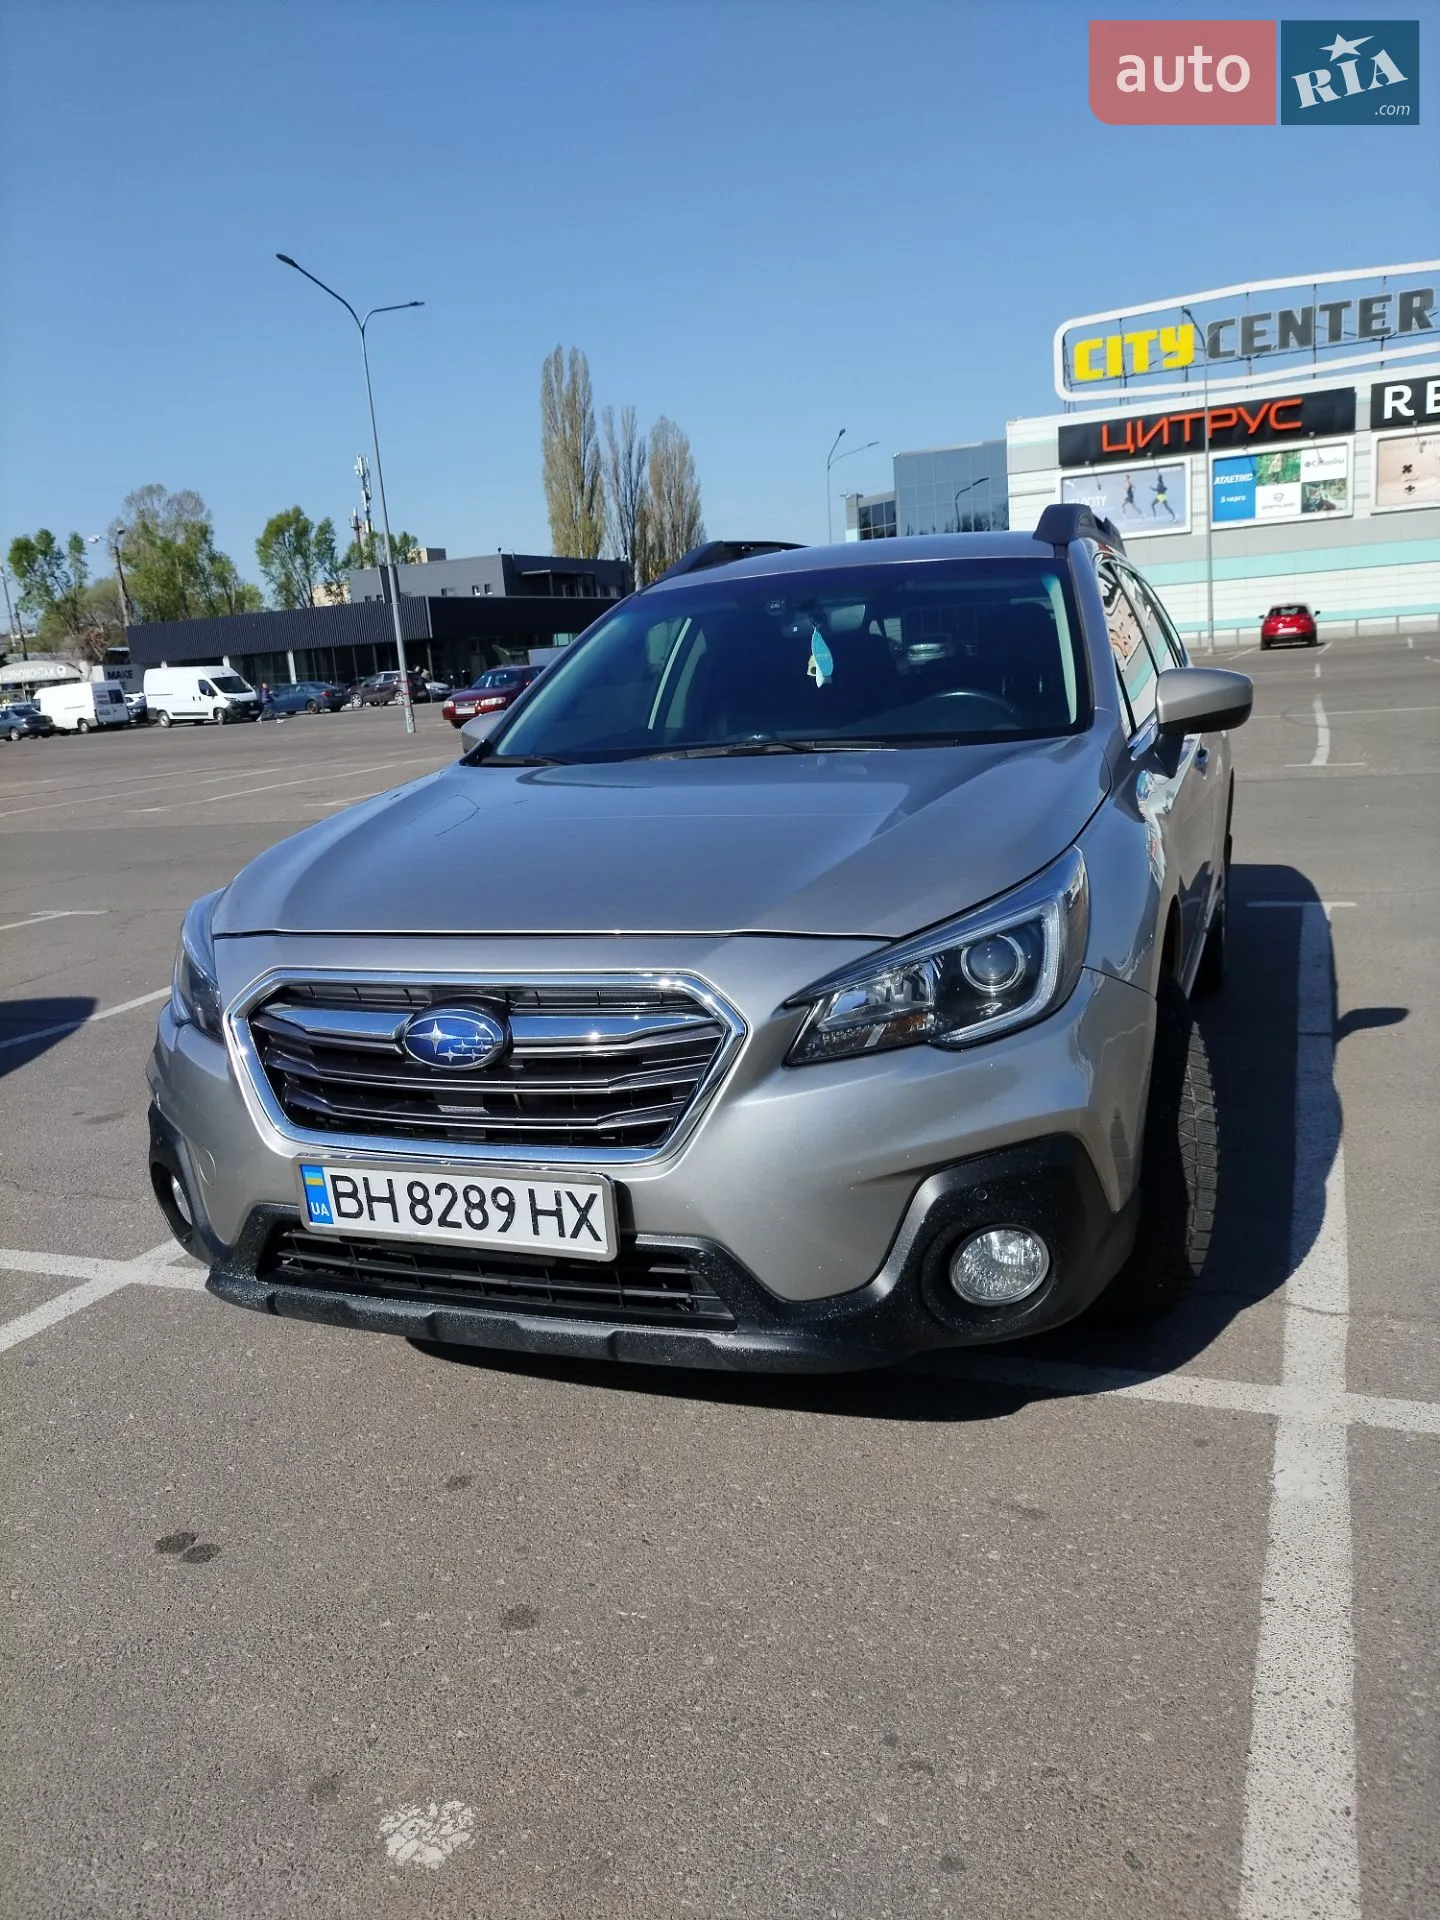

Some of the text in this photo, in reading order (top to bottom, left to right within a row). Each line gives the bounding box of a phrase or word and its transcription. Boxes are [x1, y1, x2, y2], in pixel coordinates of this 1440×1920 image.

[1073, 287, 1436, 382] CITY CENTER
[1101, 397, 1304, 454] ЦИТРУС
[310, 1201, 330, 1217] UA
[329, 1174, 603, 1242] BH 8289 HX
